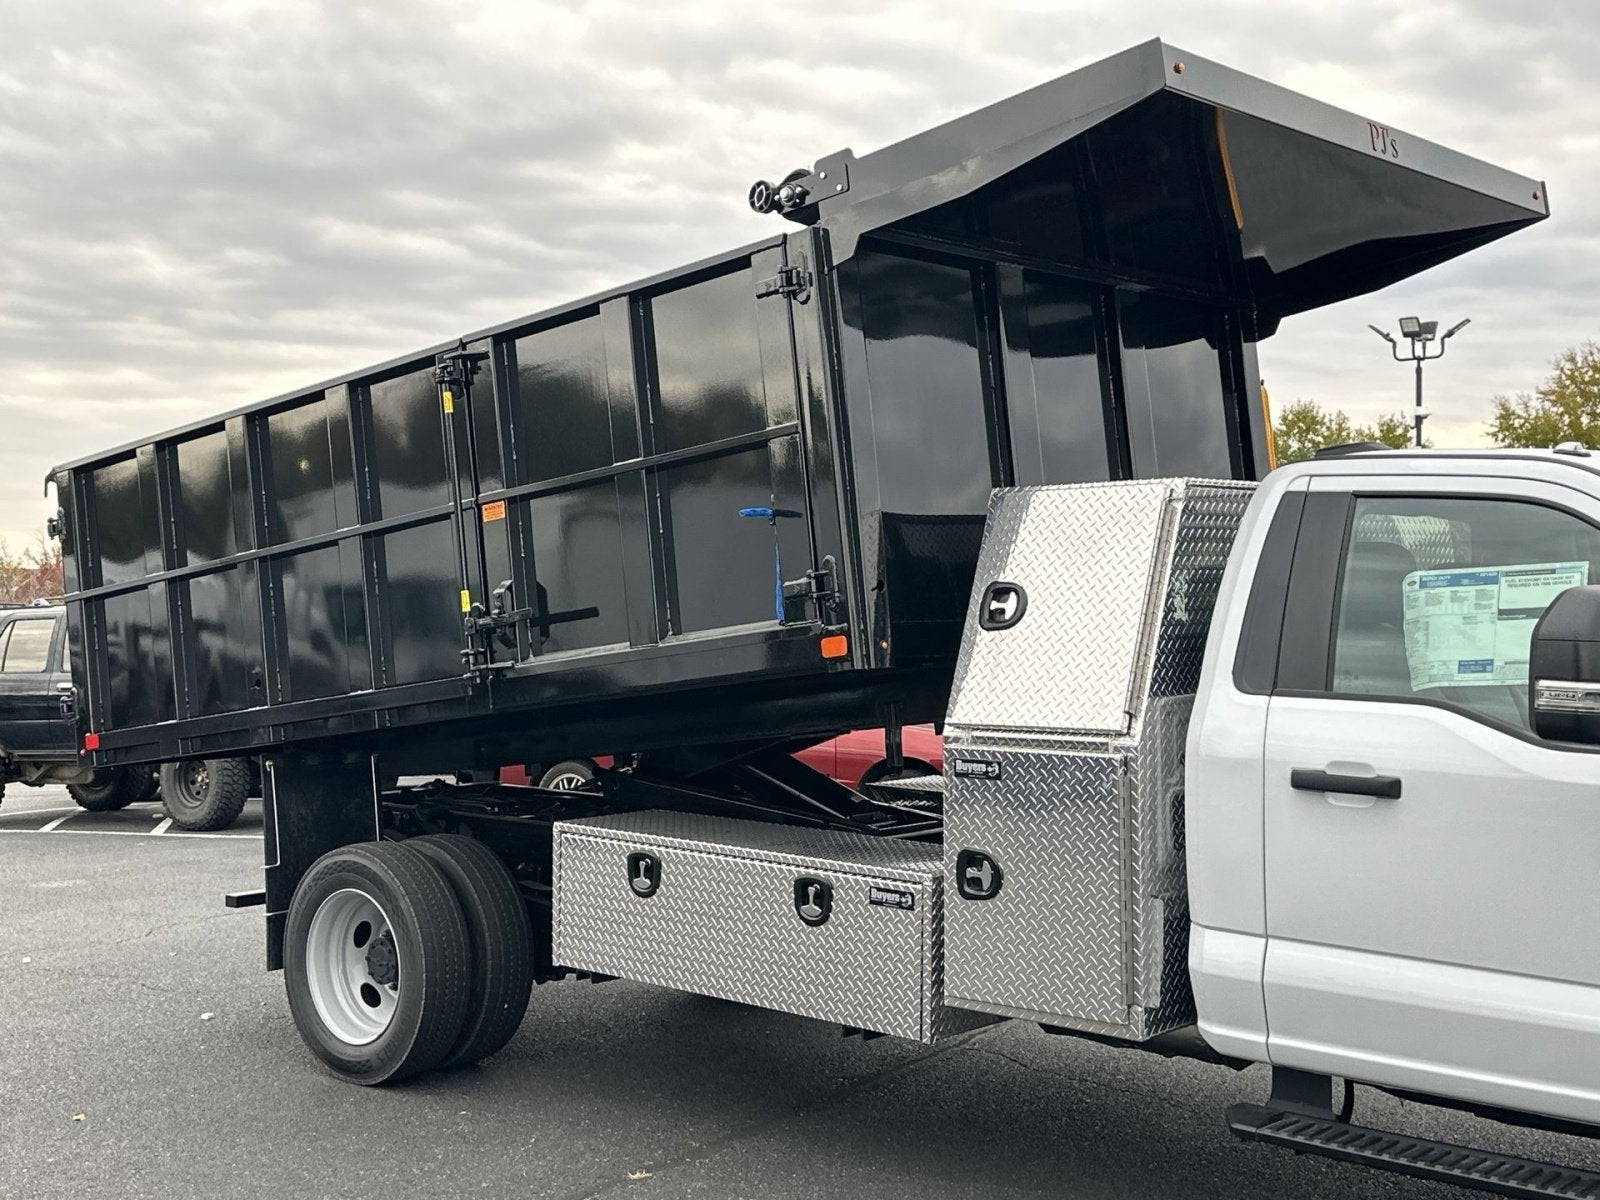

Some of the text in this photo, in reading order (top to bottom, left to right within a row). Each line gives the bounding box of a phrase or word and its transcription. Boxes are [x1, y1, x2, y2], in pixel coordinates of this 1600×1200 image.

[1367, 121, 1399, 159] PJ's
[955, 759, 987, 774] Buyers
[870, 887, 900, 902] Buyers
